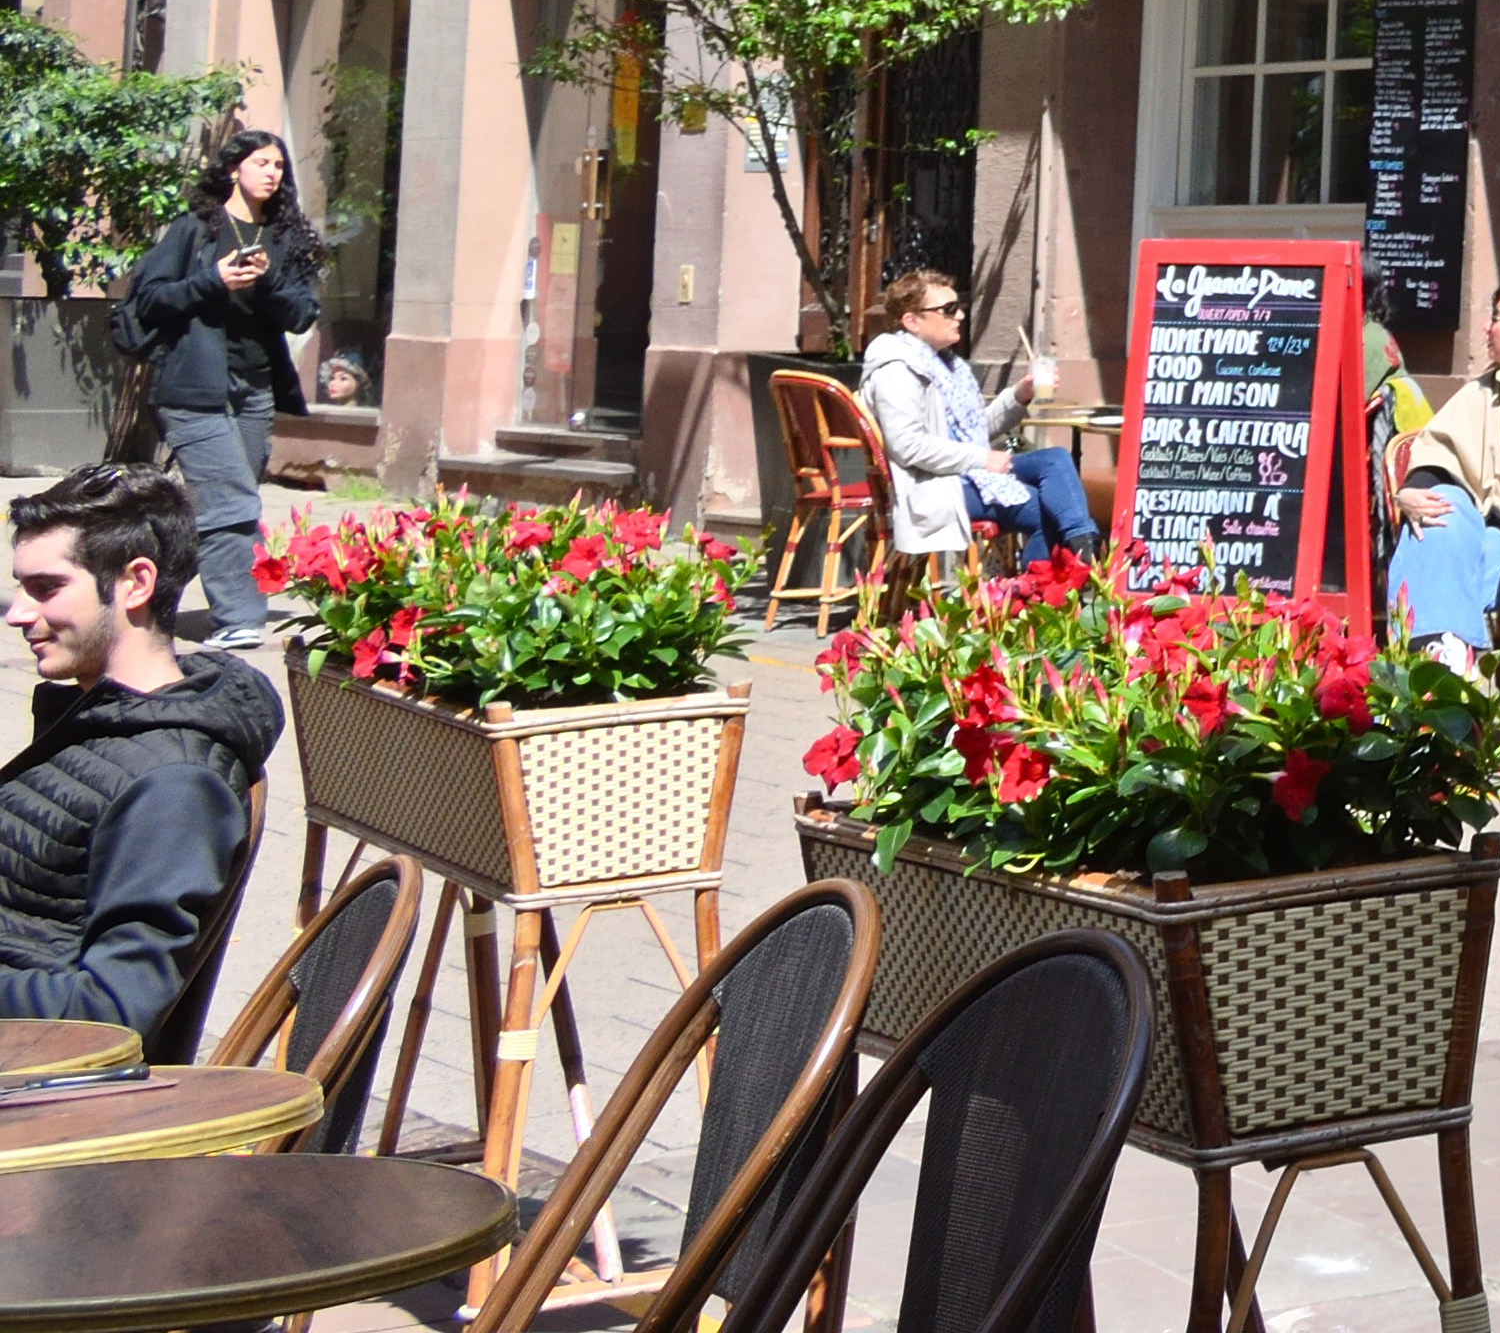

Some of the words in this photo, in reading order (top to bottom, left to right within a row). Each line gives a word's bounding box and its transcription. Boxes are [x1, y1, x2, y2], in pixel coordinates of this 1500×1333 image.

[1156, 265, 1185, 302] La
[1184, 265, 1259, 318] Grande
[1247, 269, 1316, 309] Dame
[1150, 326, 1263, 355] HOMEMADE
[1147, 355, 1202, 380] FOOD
[1144, 381, 1189, 405] FAIT
[1191, 381, 1280, 408] MAISON
[1141, 417, 1184, 447] BAR
[1184, 417, 1202, 447] &
[1206, 419, 1310, 458] CAFETERIA
[1134, 489, 1256, 519] RESTAURANT
[1145, 540, 1198, 565] NING
[1214, 542, 1264, 567] OOM
